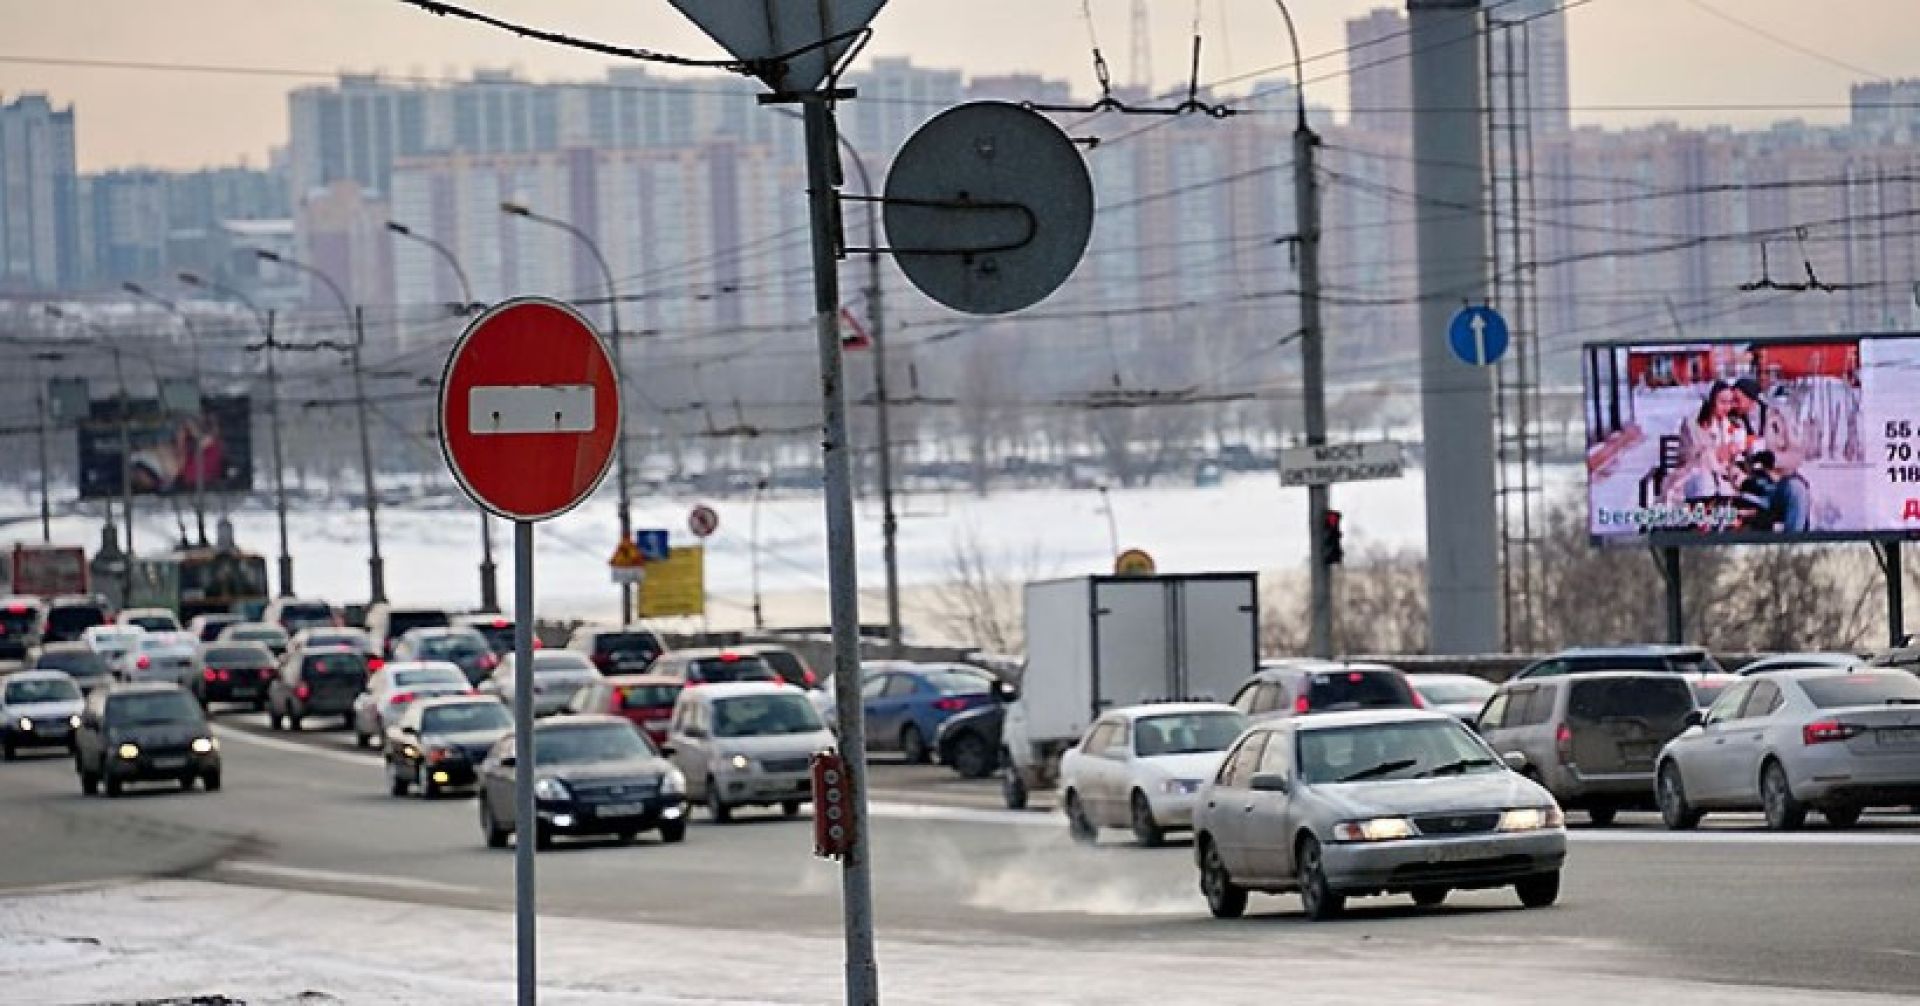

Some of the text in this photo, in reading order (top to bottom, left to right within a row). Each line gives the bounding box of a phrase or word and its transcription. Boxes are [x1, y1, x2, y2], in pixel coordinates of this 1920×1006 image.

[1885, 421, 1911, 438] 55
[1315, 443, 1363, 461] МОСТ
[1885, 443, 1911, 461] 70
